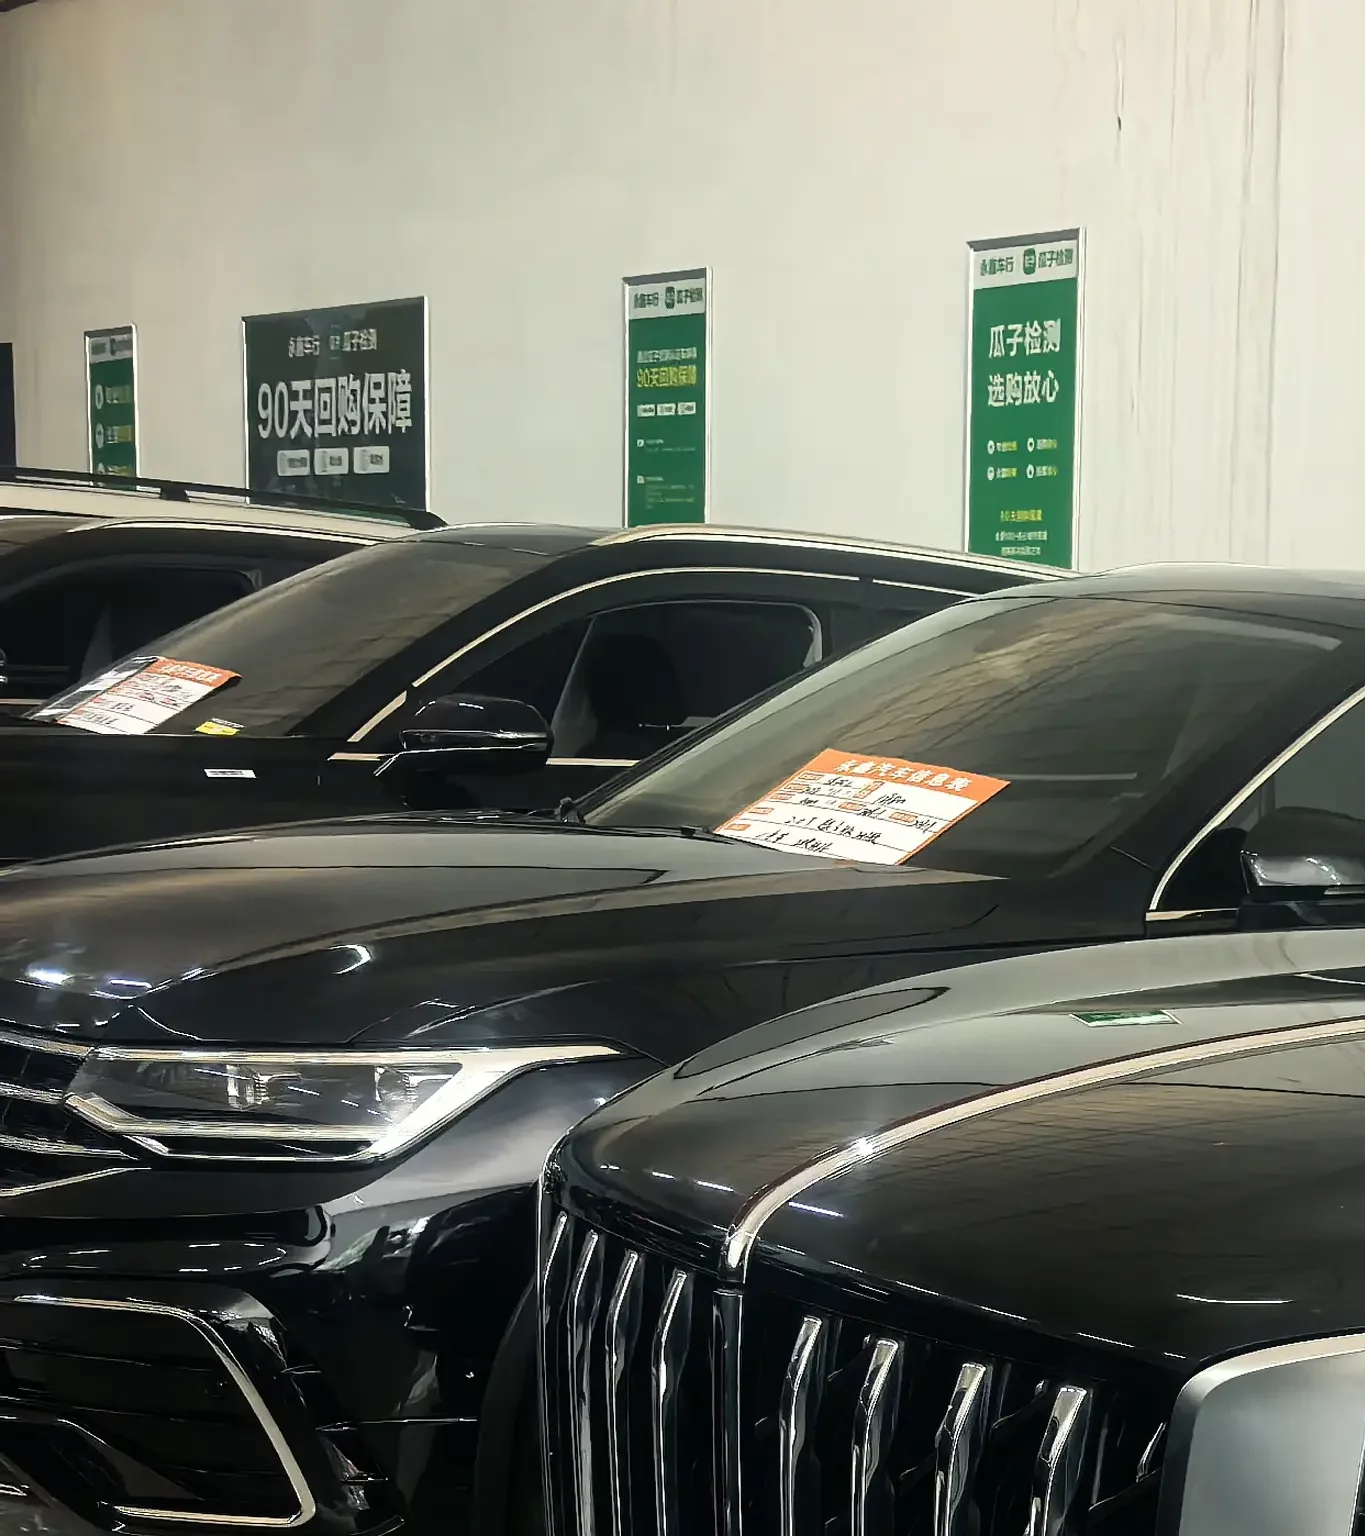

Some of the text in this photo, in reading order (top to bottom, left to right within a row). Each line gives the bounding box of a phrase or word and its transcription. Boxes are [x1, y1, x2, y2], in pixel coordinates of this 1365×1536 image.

[988, 318, 1062, 359] 瓜子检测
[257, 369, 413, 440] 90天回购保障
[987, 370, 1060, 408] 选购放心
